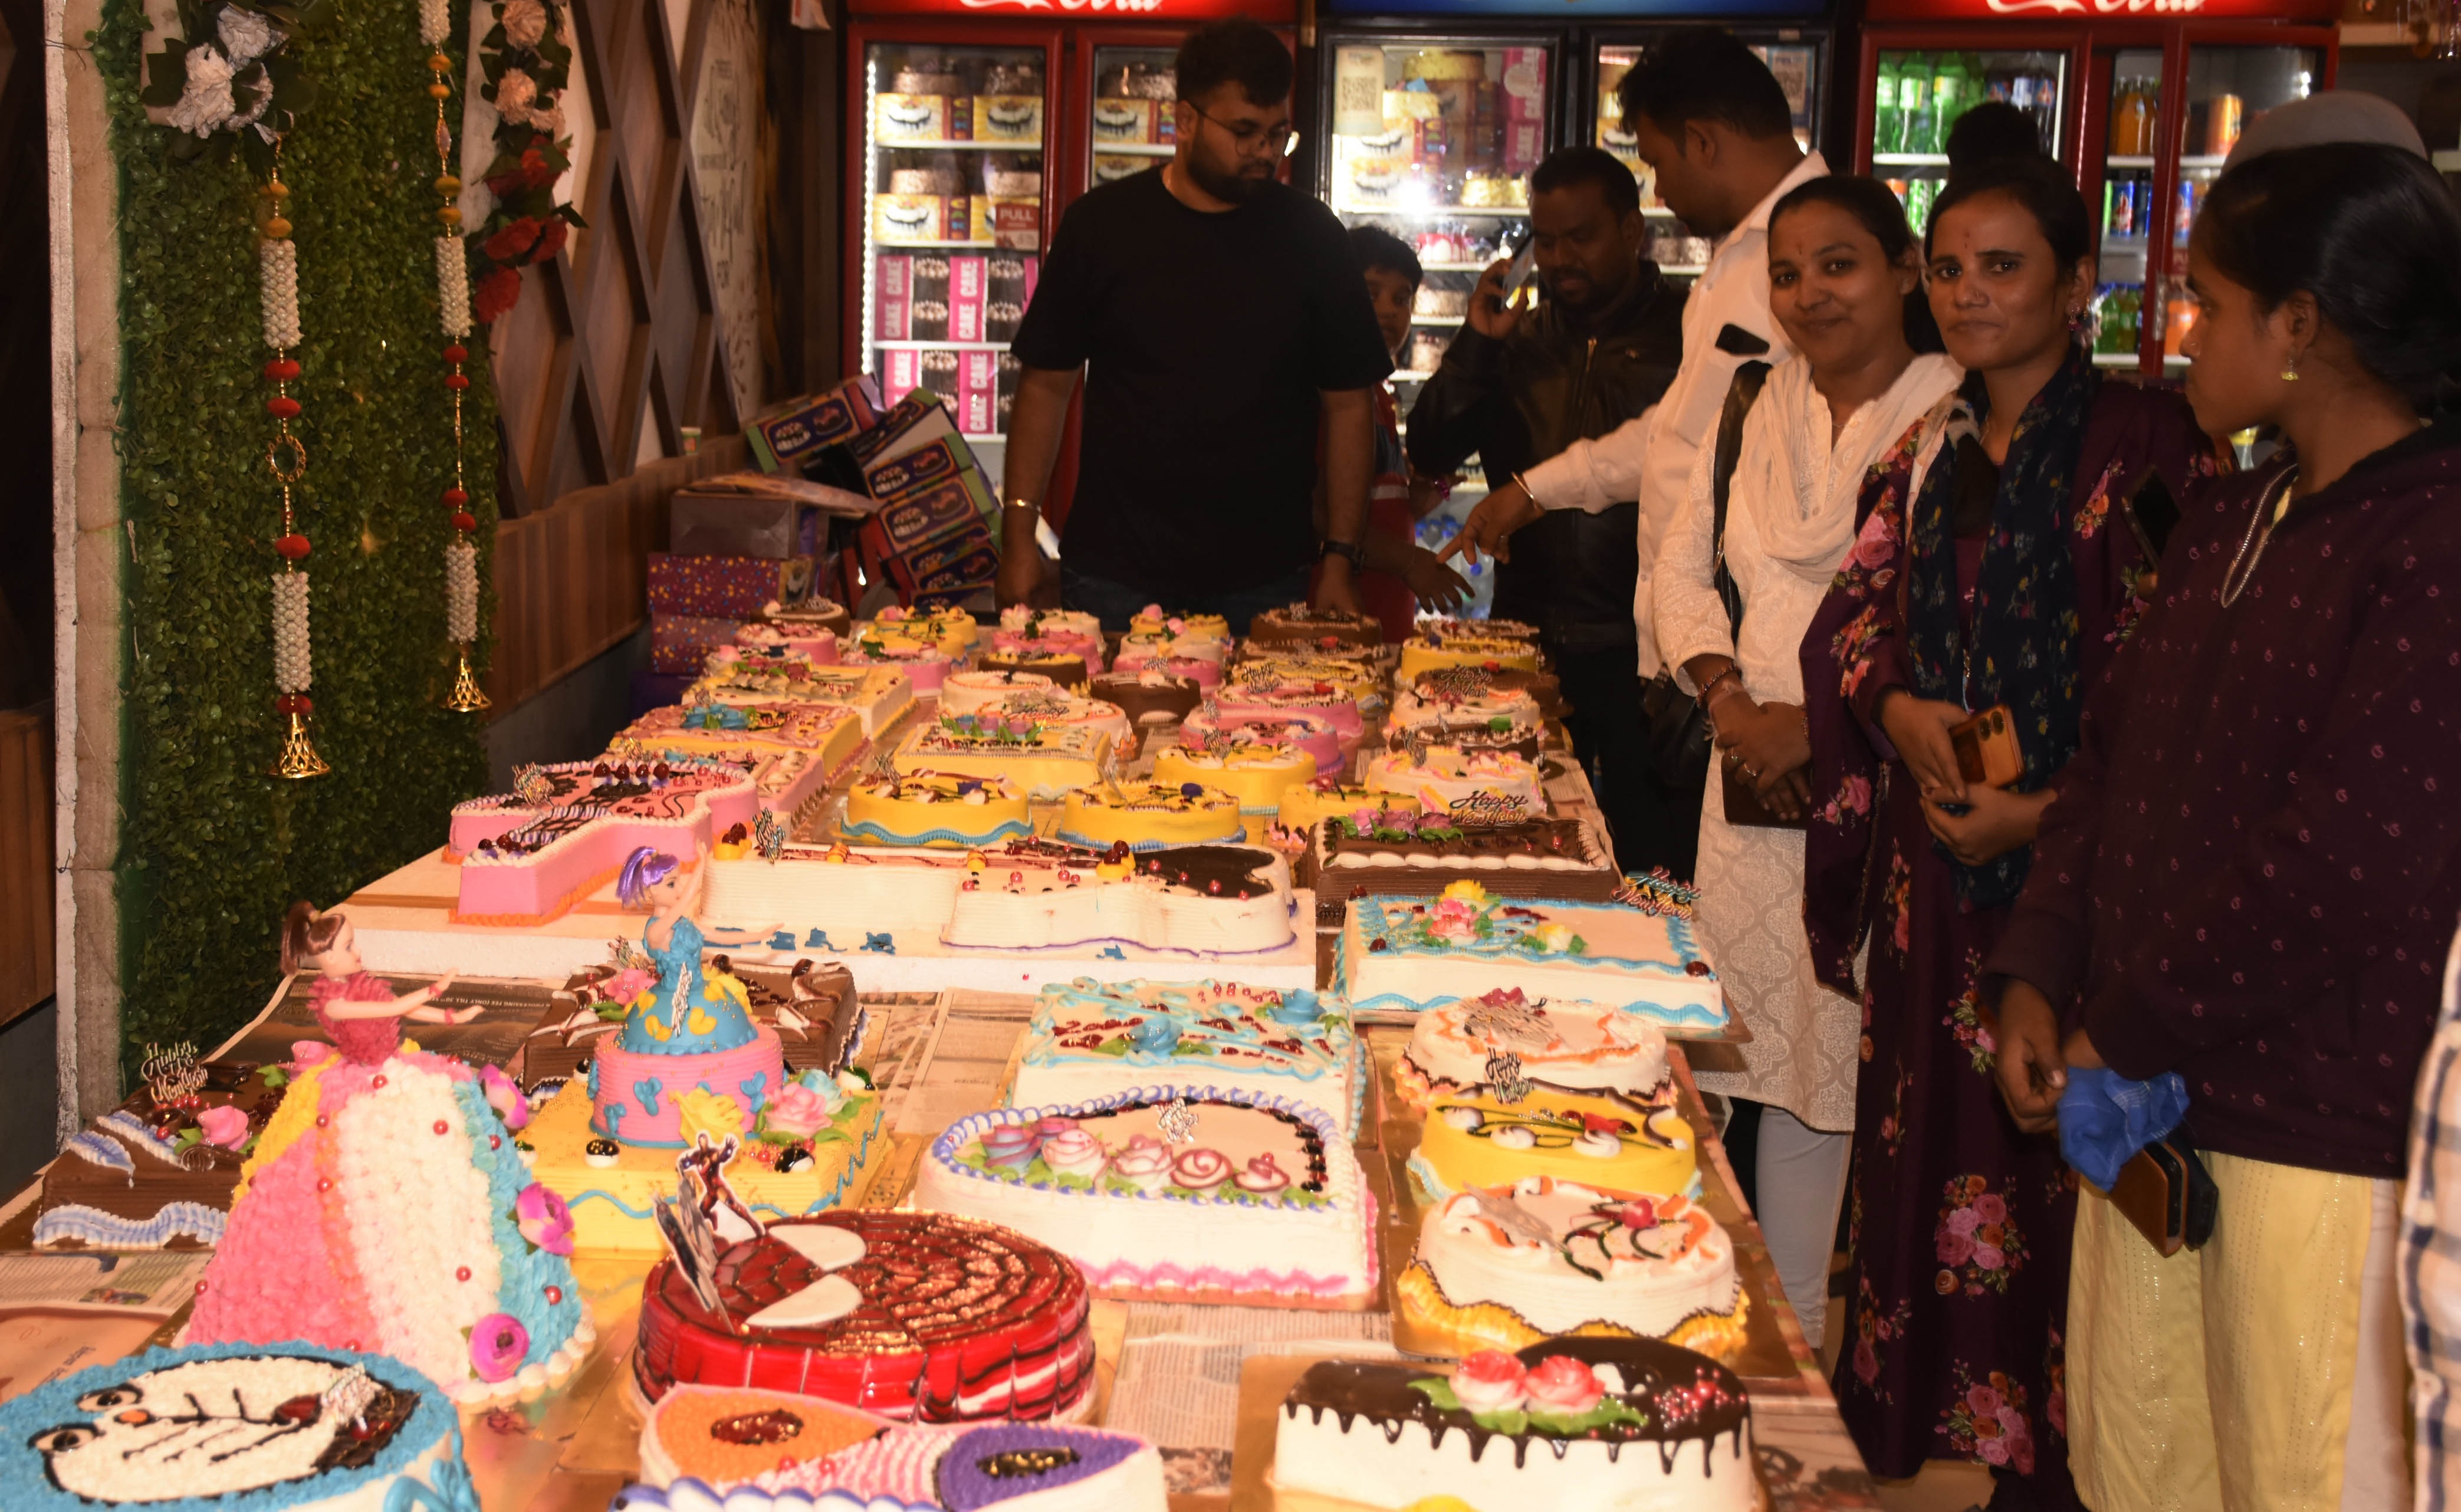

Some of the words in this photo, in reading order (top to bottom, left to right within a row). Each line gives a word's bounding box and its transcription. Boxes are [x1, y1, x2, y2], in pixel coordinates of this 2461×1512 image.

[1000, 208, 1034, 221] PULL
[886, 259, 903, 295] CAKE
[960, 261, 978, 297] CAKE
[885, 302, 902, 337] CAKE
[959, 305, 977, 339] CAKE
[894, 352, 912, 387] CAKE
[970, 354, 988, 389] CAKE
[970, 396, 987, 431] CAKE
[1450, 790, 1529, 811] Happy
[1626, 865, 1701, 904] Happy
[1486, 1047, 1522, 1083] Happy
